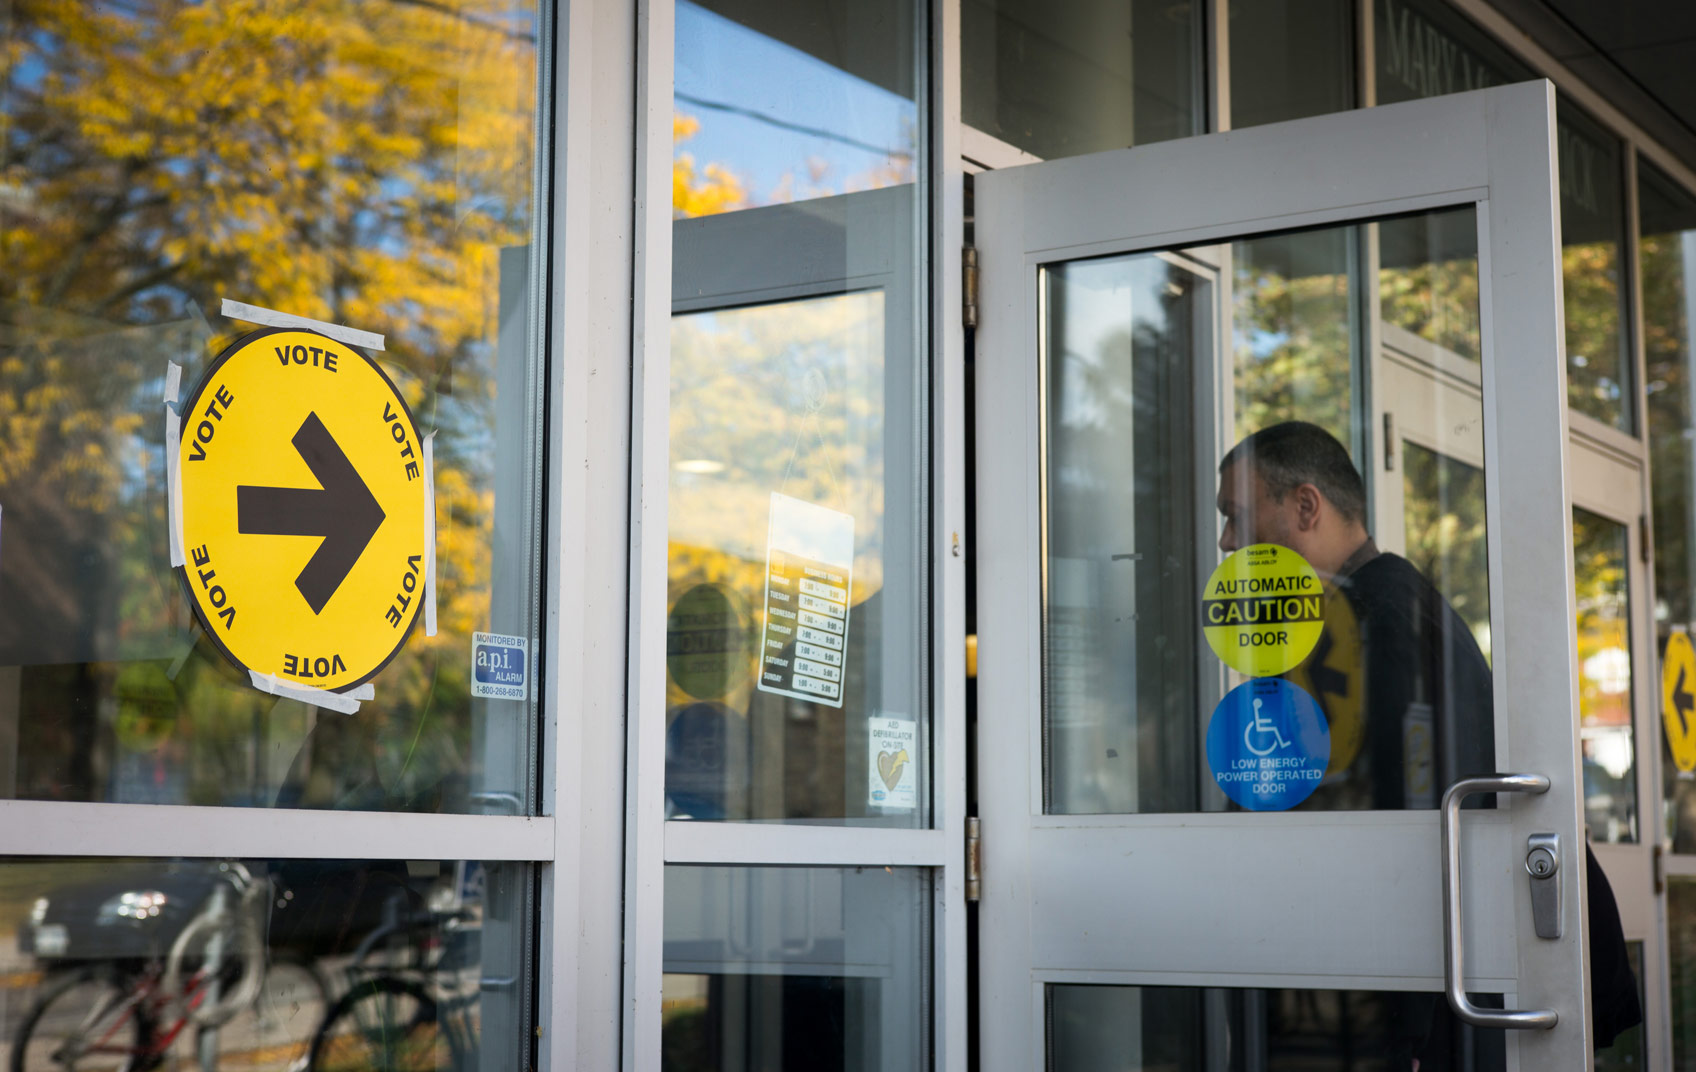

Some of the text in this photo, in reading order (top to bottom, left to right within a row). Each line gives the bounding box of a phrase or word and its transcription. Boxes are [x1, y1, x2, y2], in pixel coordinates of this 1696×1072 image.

[274, 344, 339, 373] VOTE
[188, 384, 235, 462] VOTE
[383, 401, 420, 482] VOTE
[191, 543, 237, 631] VOTE
[385, 554, 422, 629] VOTE
[1215, 575, 1312, 595] AUTOMATIC
[770, 590, 790, 602] TUESDAY
[769, 606, 796, 620] WEDNESDAY
[1208, 597, 1320, 624] CAUTION
[477, 634, 526, 647] MONITORED BY
[1239, 631, 1288, 647] DOOR
[283, 653, 347, 678] VOTE
[477, 648, 512, 672] a.p.i.
[765, 655, 789, 667] SATURDAY
[496, 672, 522, 683] ALARM
[763, 671, 782, 682] SUNDAY
[476, 685, 524, 697] 1-800-268-6870
[873, 729, 913, 740] DEFIBRILLATOR
[1231, 757, 1306, 769] LOW ENERGY
[1217, 769, 1322, 782] POWER OPERATED
[1252, 783, 1286, 794] DOOR
